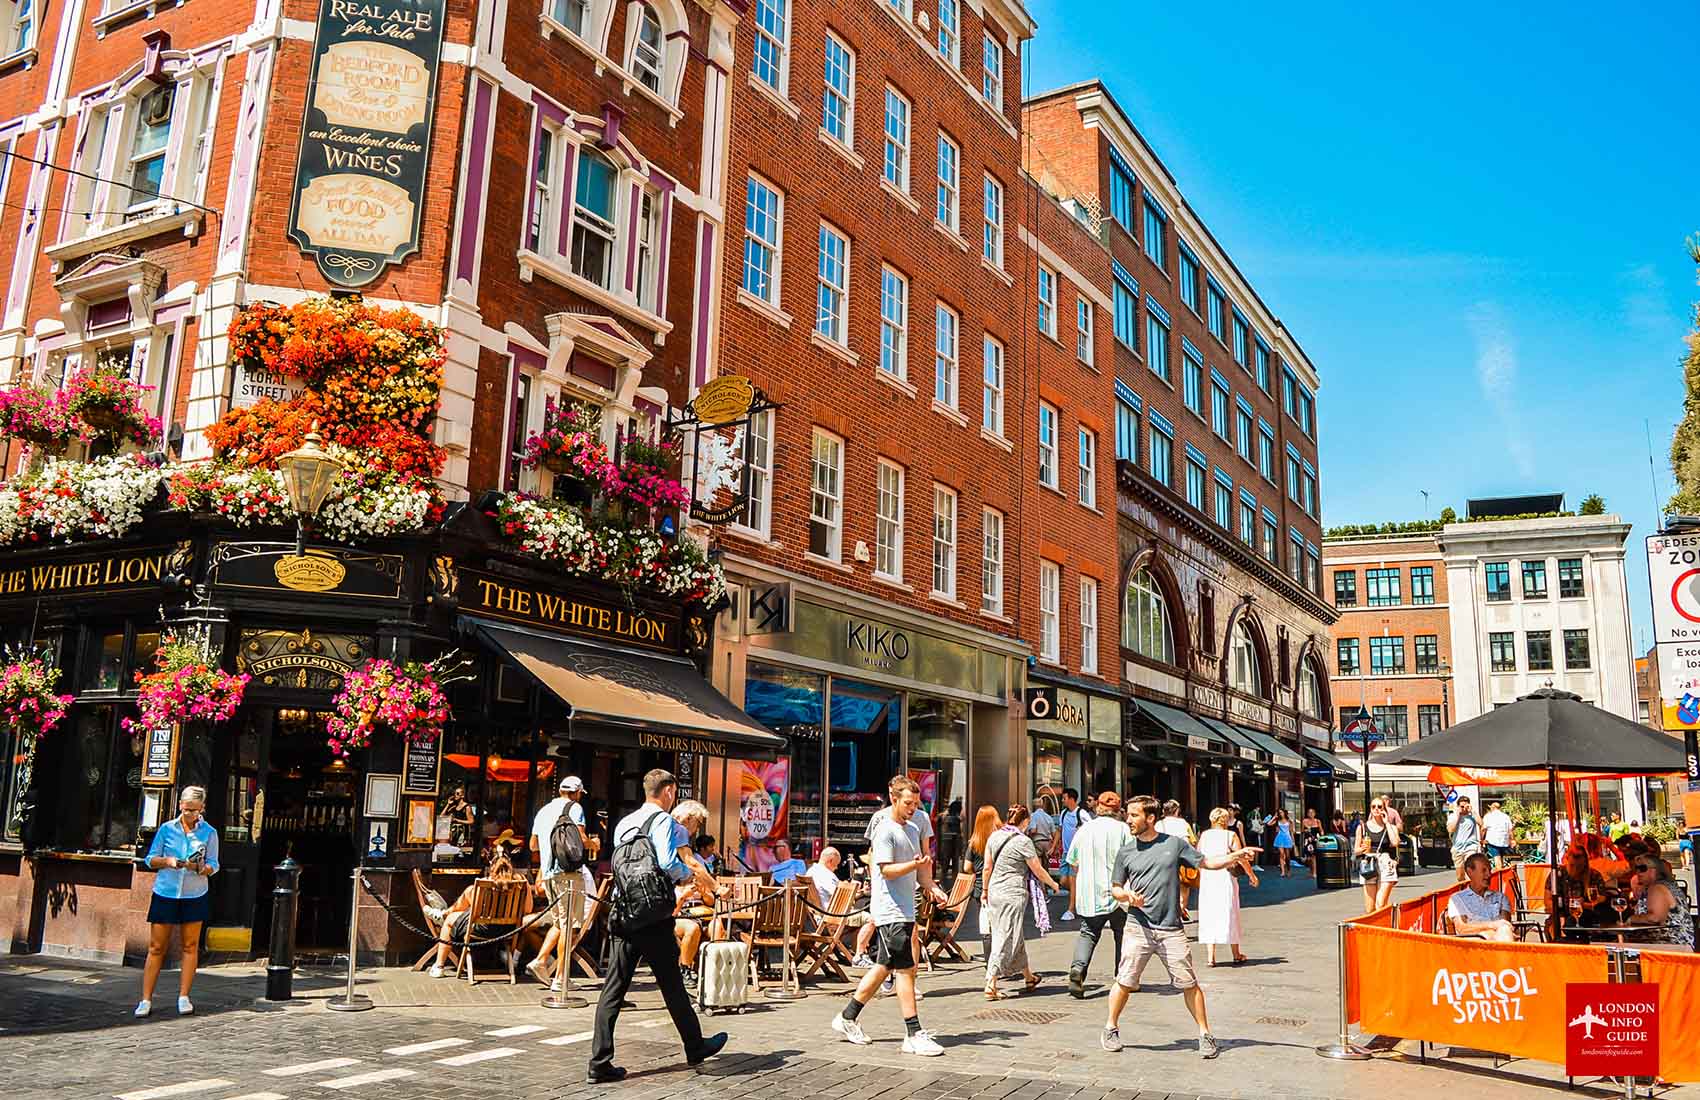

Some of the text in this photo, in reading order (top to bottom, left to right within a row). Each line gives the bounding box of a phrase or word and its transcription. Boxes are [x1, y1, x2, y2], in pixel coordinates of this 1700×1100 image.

[329, 0, 432, 31] REAL ALE
[341, 19, 416, 40] for Sale
[309, 126, 422, 153] an Excellent choice
[322, 143, 402, 177] WINES
[241, 384, 287, 402] STREET
[0, 555, 163, 593] HE WHITE LION
[478, 579, 667, 643] THE WHITE LION
[847, 619, 909, 660] KIKO
[1671, 628, 1688, 638] No
[256, 655, 350, 673] NICHOLSON'S
[638, 731, 726, 756] UPSTAIRS DINING
[747, 807, 773, 821] SALE
[753, 823, 768, 833] 70%
[1432, 967, 1537, 1006] APEROL
